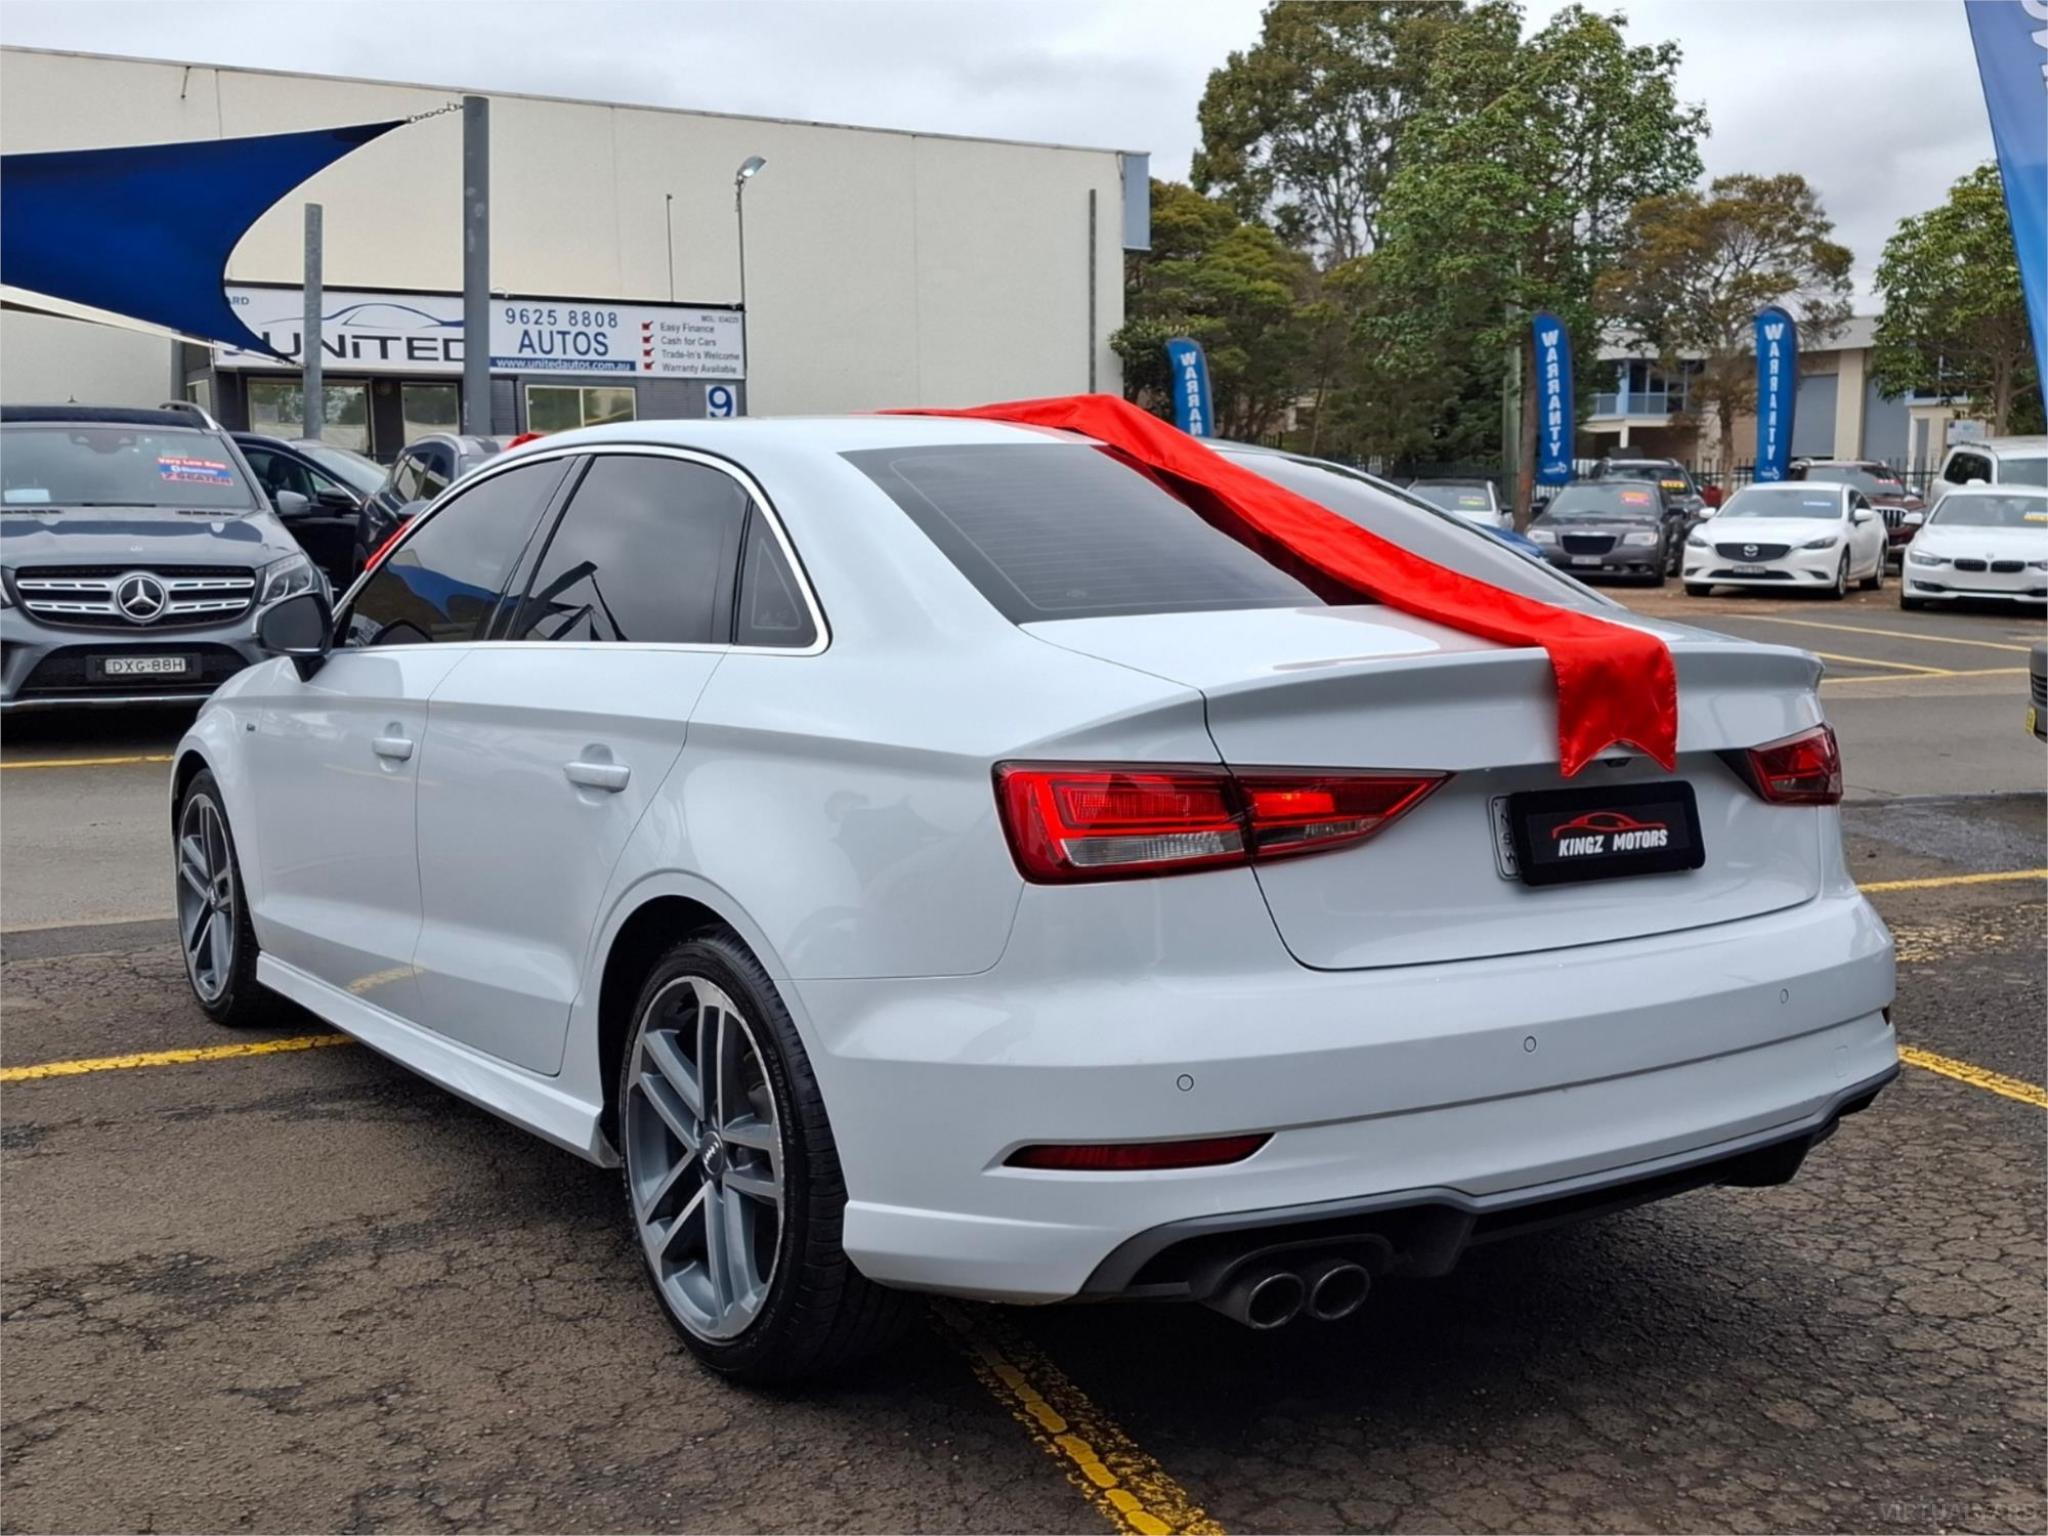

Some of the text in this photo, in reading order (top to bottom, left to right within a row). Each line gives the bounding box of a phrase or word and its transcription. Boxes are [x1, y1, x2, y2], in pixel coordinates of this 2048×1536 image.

[505, 307, 618, 328] 9625 8808
[660, 322, 715, 334] Easy Finance
[518, 329, 609, 357] AUTOS
[660, 336, 716, 346] Cash for Cars
[496, 359, 630, 371] www.unitedautos.com.au
[662, 363, 699, 374] Warranty
[708, 386, 733, 417] 9
[1558, 829, 1668, 857] KINGZ MOTORS
